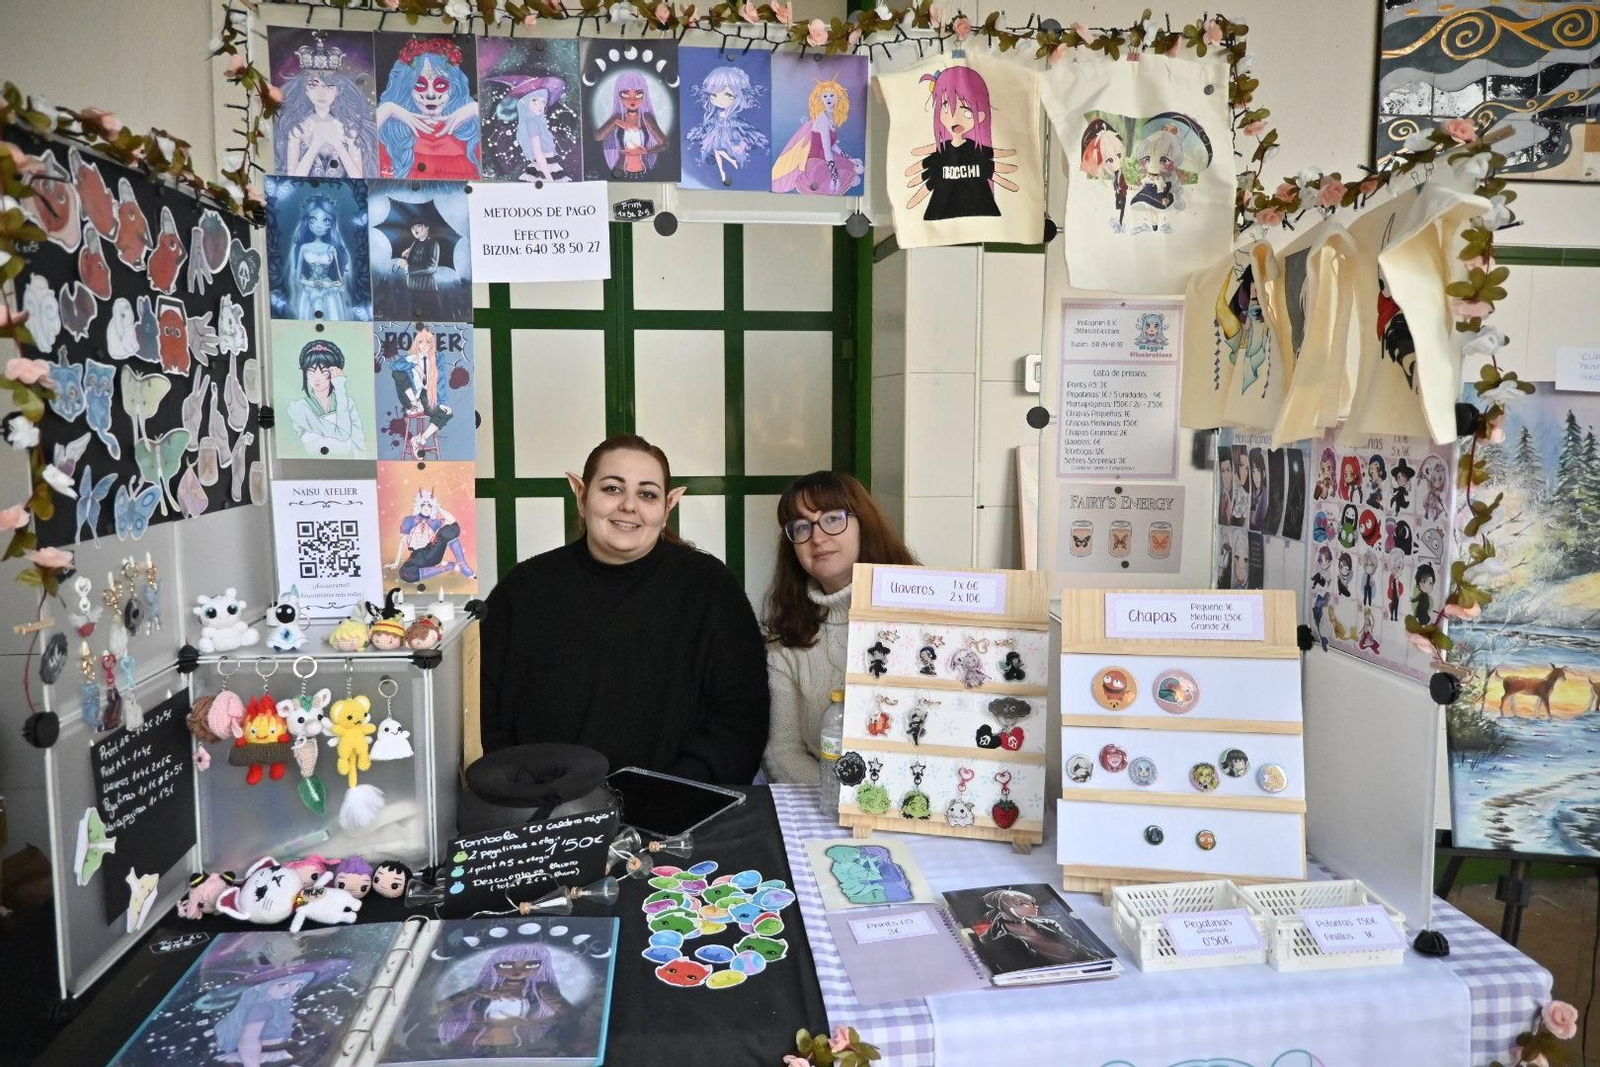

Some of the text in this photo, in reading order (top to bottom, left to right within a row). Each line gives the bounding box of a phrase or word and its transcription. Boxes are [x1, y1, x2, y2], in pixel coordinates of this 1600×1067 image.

[942, 165, 980, 179] BOCCHI
[484, 204, 596, 218] METODOS DE PAGO
[514, 229, 570, 241] EFECTIVO
[526, 244, 547, 254] 640
[552, 242, 566, 254] 38
[569, 242, 584, 254] 50
[588, 240, 600, 252] 27
[385, 331, 462, 352] POER
[1093, 369, 1110, 377] Lista
[293, 487, 358, 496] NAISU ATELIER
[1121, 496, 1174, 510] ENERGY
[953, 580, 957, 590] 1
[967, 580, 979, 590] 6€
[950, 592, 955, 602] 2
[966, 593, 980, 603] 10€
[1128, 609, 1177, 625] Chapas
[1221, 623, 1231, 631] 2€
[454, 830, 518, 849] Tombola
[468, 850, 477, 860] 2
[480, 842, 528, 859] pegatinas
[475, 863, 496, 875] print
[867, 921, 898, 930] Prints
[1184, 919, 1232, 930] Pegatinas
